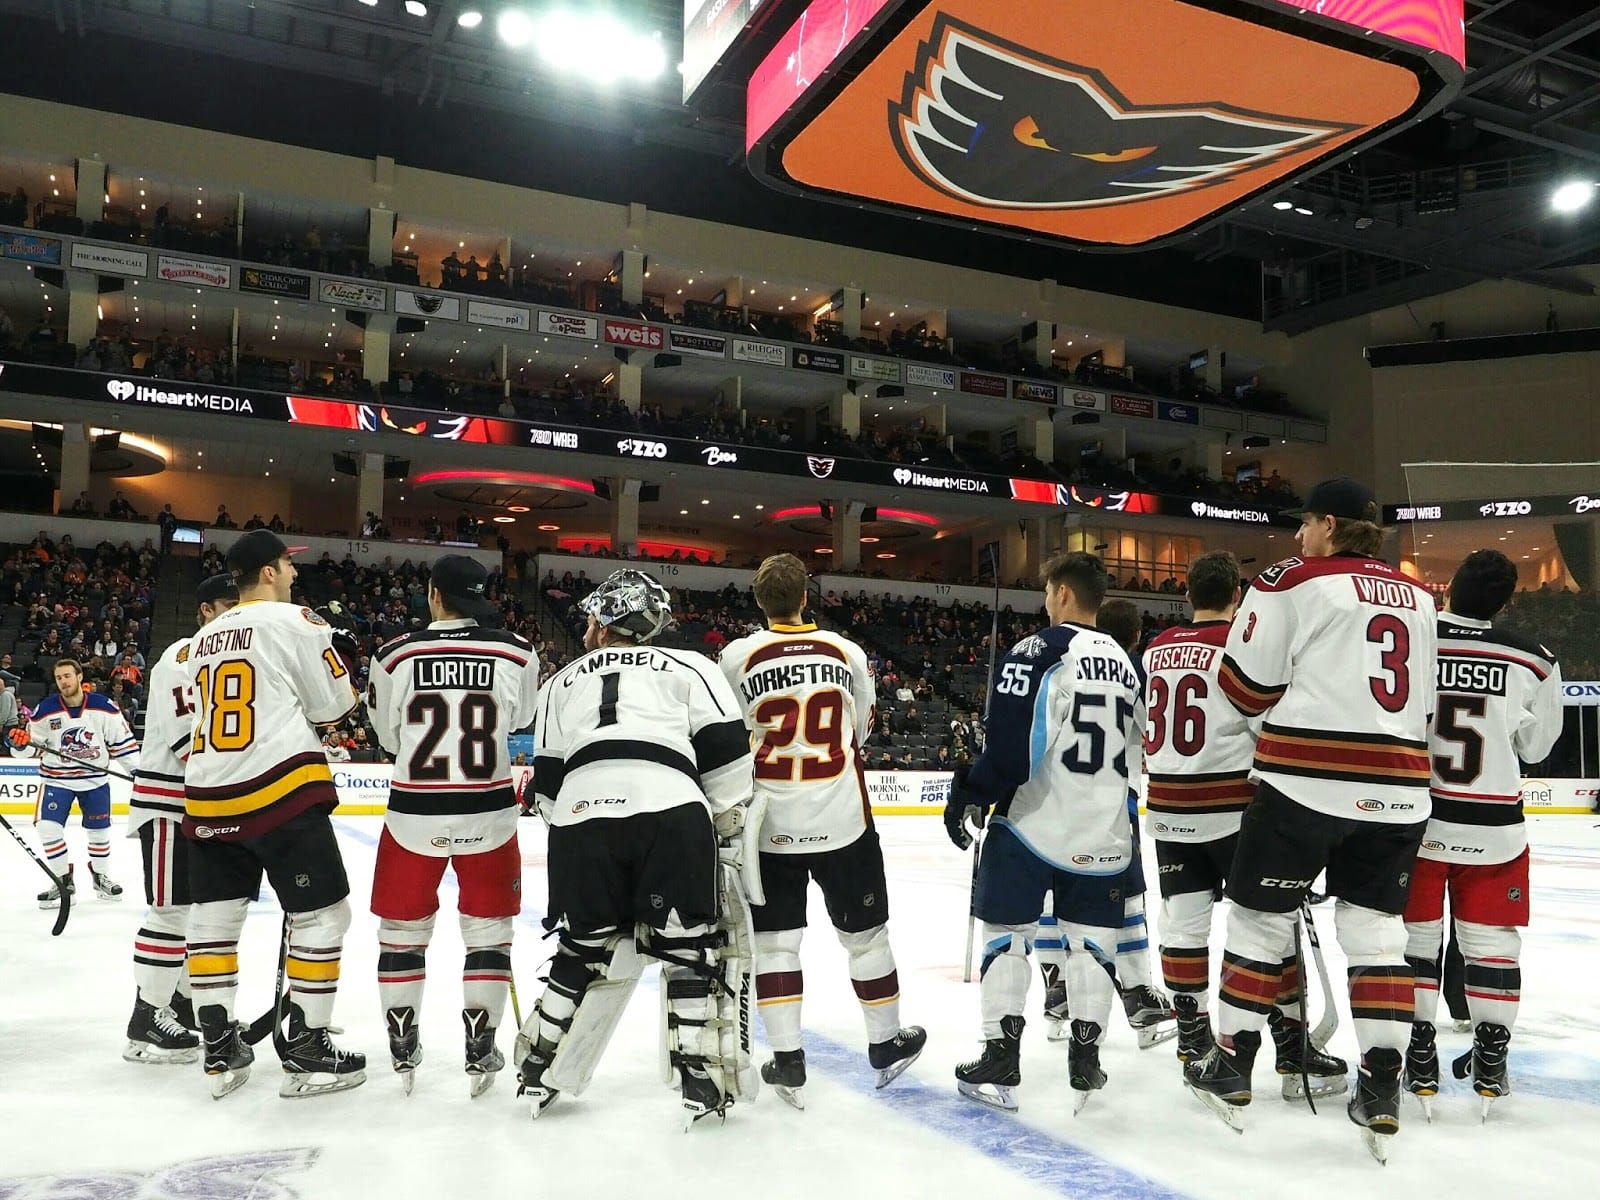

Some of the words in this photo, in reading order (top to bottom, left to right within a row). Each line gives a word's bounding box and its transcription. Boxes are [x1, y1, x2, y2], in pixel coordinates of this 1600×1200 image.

[607, 325, 661, 346] weis
[137, 385, 253, 413] iHeartMEDIA
[1028, 386, 1054, 400] NEWS
[912, 473, 988, 493] iHeartMEDIA
[1207, 505, 1269, 523] iHeartMEDIA
[348, 541, 369, 553] 115
[660, 565, 679, 576] 116
[1364, 563, 1392, 573] CCM
[935, 585, 951, 595] 117
[1359, 578, 1415, 608] WOOD
[1169, 602, 1184, 613] 118
[1242, 612, 1257, 643] 3
[1448, 628, 1483, 636] CCM
[195, 627, 253, 658] AGOSTINO
[783, 644, 814, 652] CCM
[1151, 648, 1210, 671] FISCHER
[1366, 613, 1410, 713] 3
[418, 660, 491, 687] LORITO
[563, 651, 674, 688] CAMPBELL
[740, 663, 854, 705] BJORKSTRAN
[996, 662, 1033, 697] 55
[191, 658, 256, 754] 18
[591, 672, 621, 730] 1
[1145, 673, 1209, 757] 36
[406, 692, 499, 782] 28
[753, 688, 847, 783] 29
[1432, 693, 1487, 786] 5
[333, 772, 389, 789] Ciocca
[880, 775, 898, 784] THE
[868, 784, 910, 793] MORNING
[878, 793, 900, 801] CALL
[921, 784, 944, 793] FIRST
[921, 792, 944, 803] FOR
[1390, 802, 1414, 810] CCM
[214, 825, 240, 834] CCM
[454, 836, 484, 844] CCM
[799, 835, 829, 843] CCM
[1099, 854, 1122, 862] CCM
[1450, 846, 1485, 854] CCM
[1260, 877, 1311, 889] CCM
[740, 972, 750, 1055] VAUGHN
